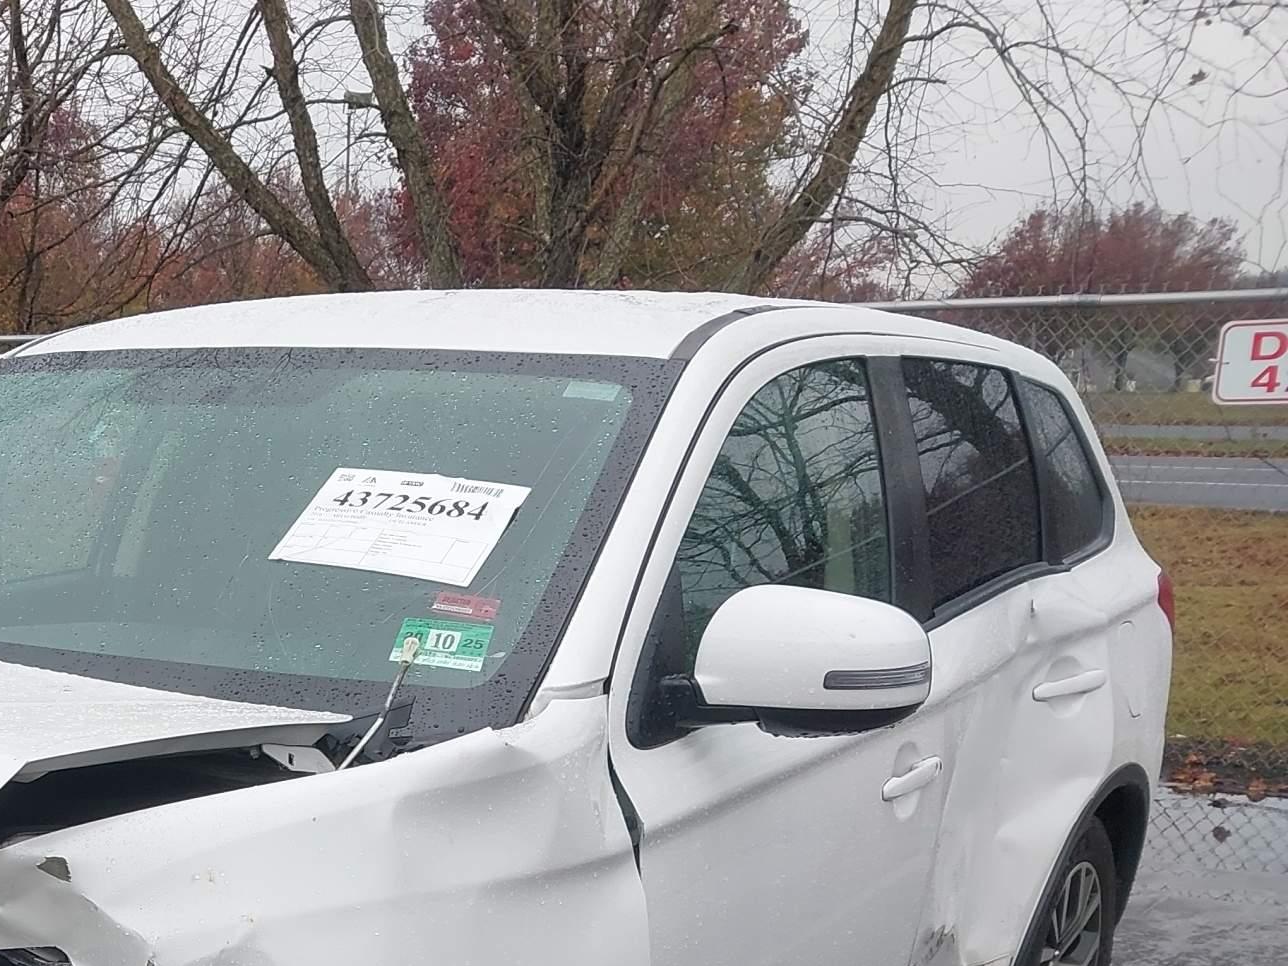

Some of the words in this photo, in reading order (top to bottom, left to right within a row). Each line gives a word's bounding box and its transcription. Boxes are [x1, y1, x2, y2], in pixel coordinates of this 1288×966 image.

[332, 489, 489, 521] 43725684
[431, 632, 456, 650] 10
[462, 638, 485, 650] 25
